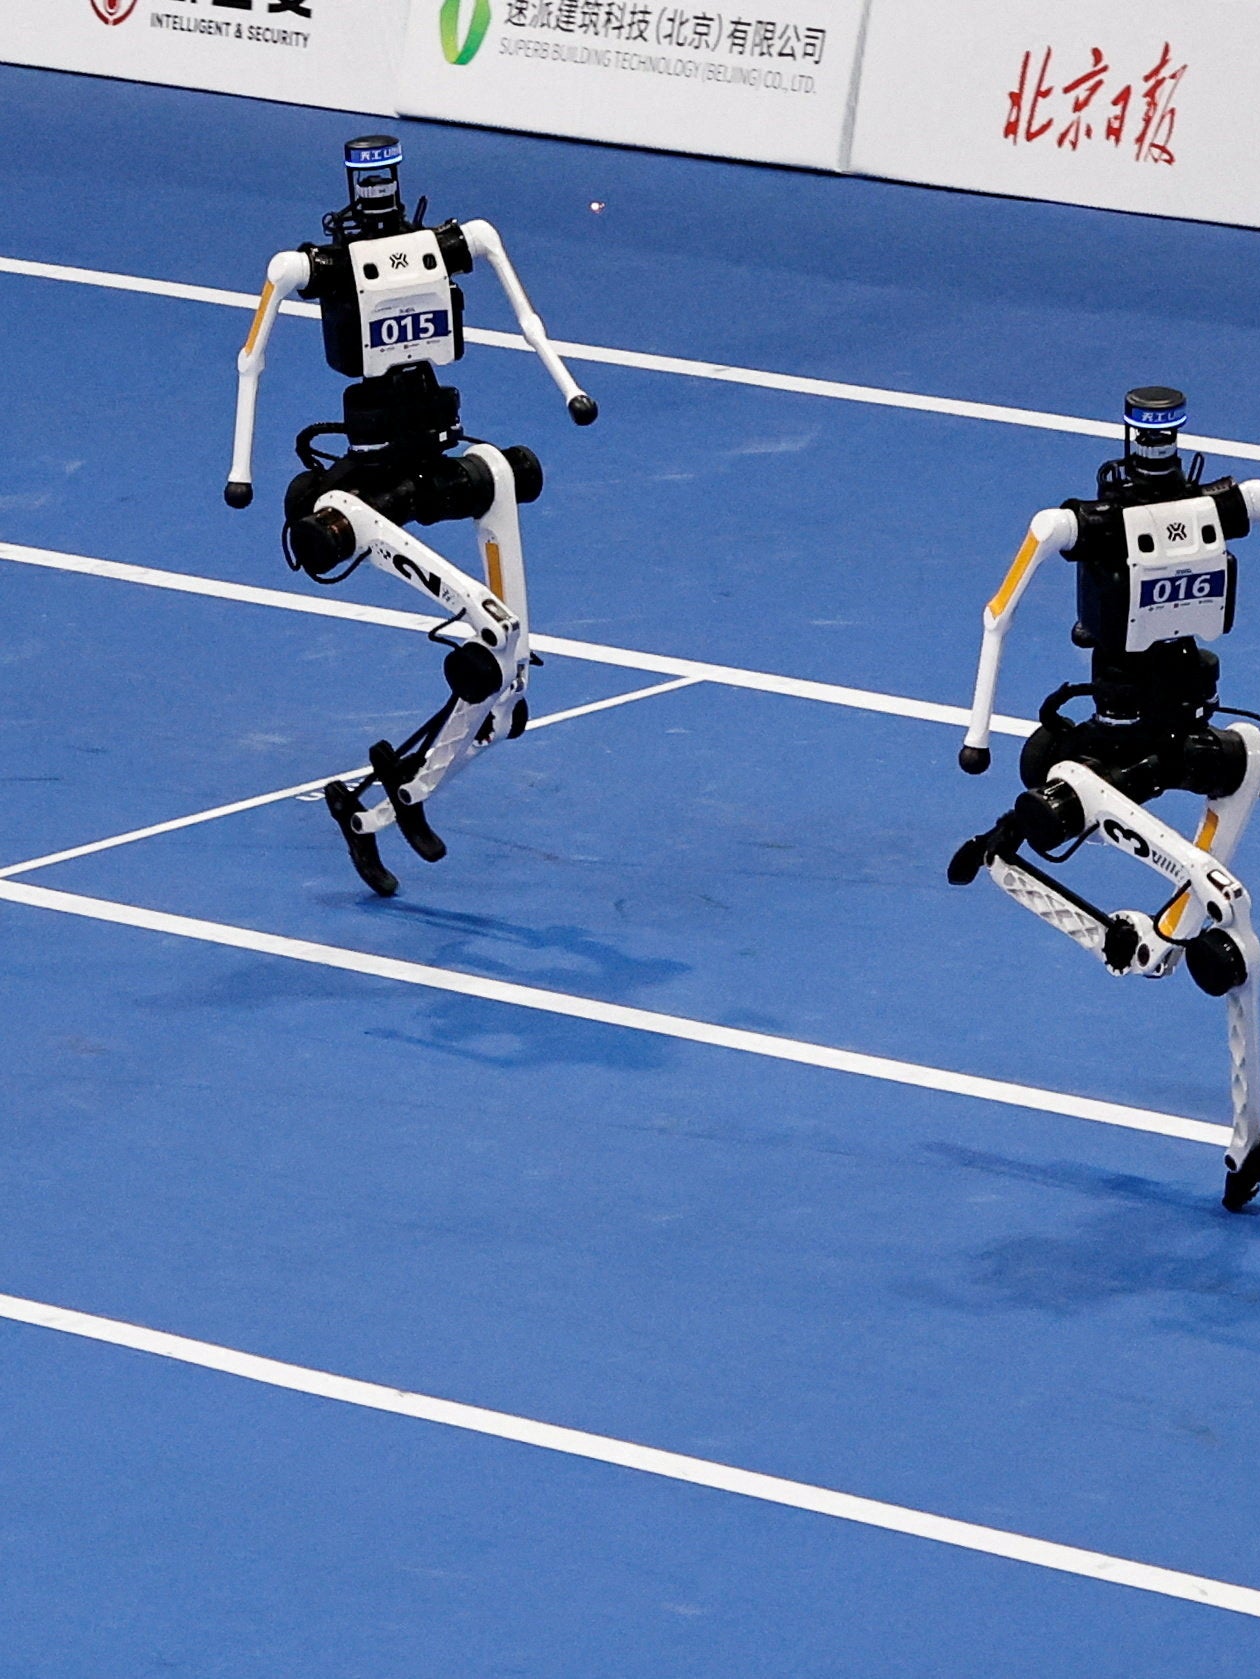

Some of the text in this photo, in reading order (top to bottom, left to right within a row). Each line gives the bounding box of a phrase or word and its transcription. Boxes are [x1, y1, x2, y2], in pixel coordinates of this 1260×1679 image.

[150, 12, 310, 48] INTELLIGENT & SECURITY
[499, 36, 549, 61] SUPERB
[552, 44, 612, 69] BUILDING
[614, 51, 700, 79] TECHNOLOGY
[701, 61, 762, 91] (BEIJING)
[381, 313, 435, 344] 015
[392, 553, 442, 598] 2
[1153, 574, 1211, 603] 016
[1103, 818, 1150, 858] 3
